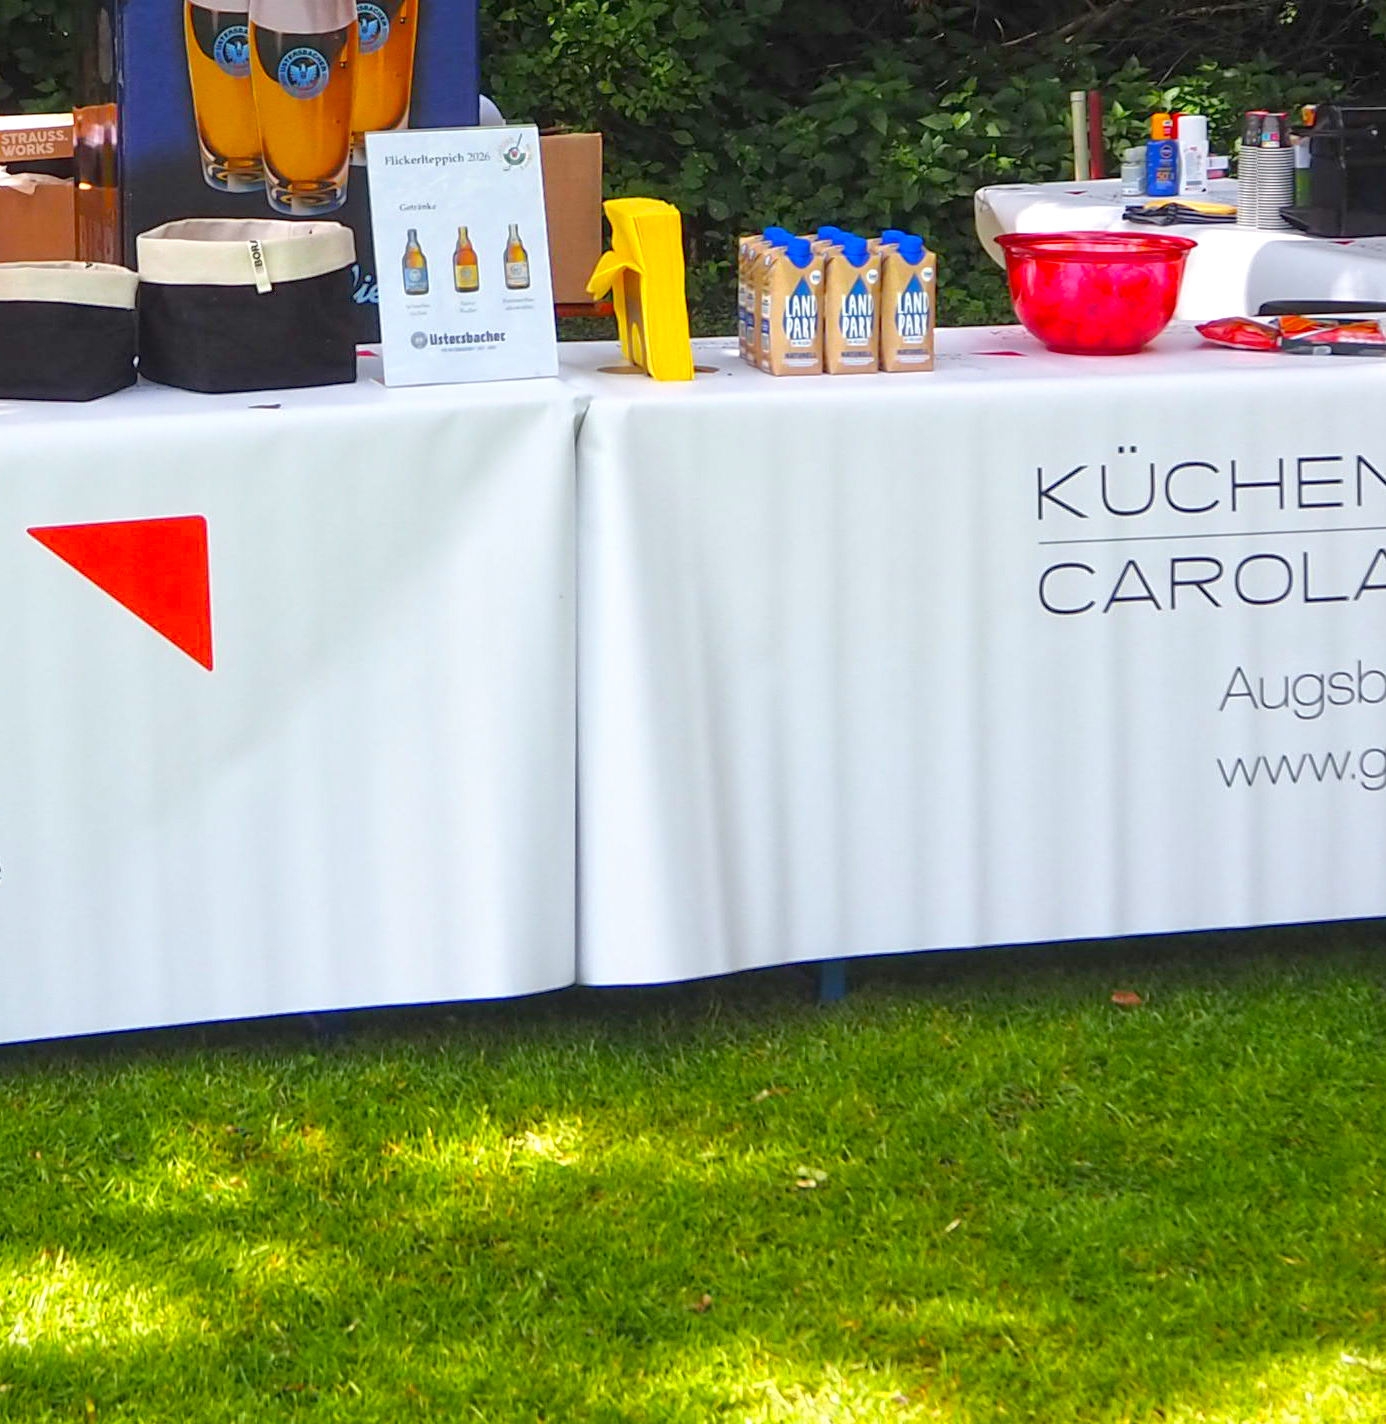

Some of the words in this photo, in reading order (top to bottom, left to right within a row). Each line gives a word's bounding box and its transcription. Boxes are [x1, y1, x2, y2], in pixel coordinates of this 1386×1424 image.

[0, 129, 69, 146] STRAUSS.
[0, 142, 55, 157] WORKS
[384, 153, 465, 166] Flickerlteppich
[466, 151, 491, 162] 2026
[785, 295, 817, 317] LAND
[841, 294, 874, 316] LAND
[897, 292, 930, 314] LAND
[786, 317, 816, 339] PARK
[841, 316, 873, 339] PARK
[897, 314, 928, 336] PARK
[429, 330, 506, 346] Ustersbacher
